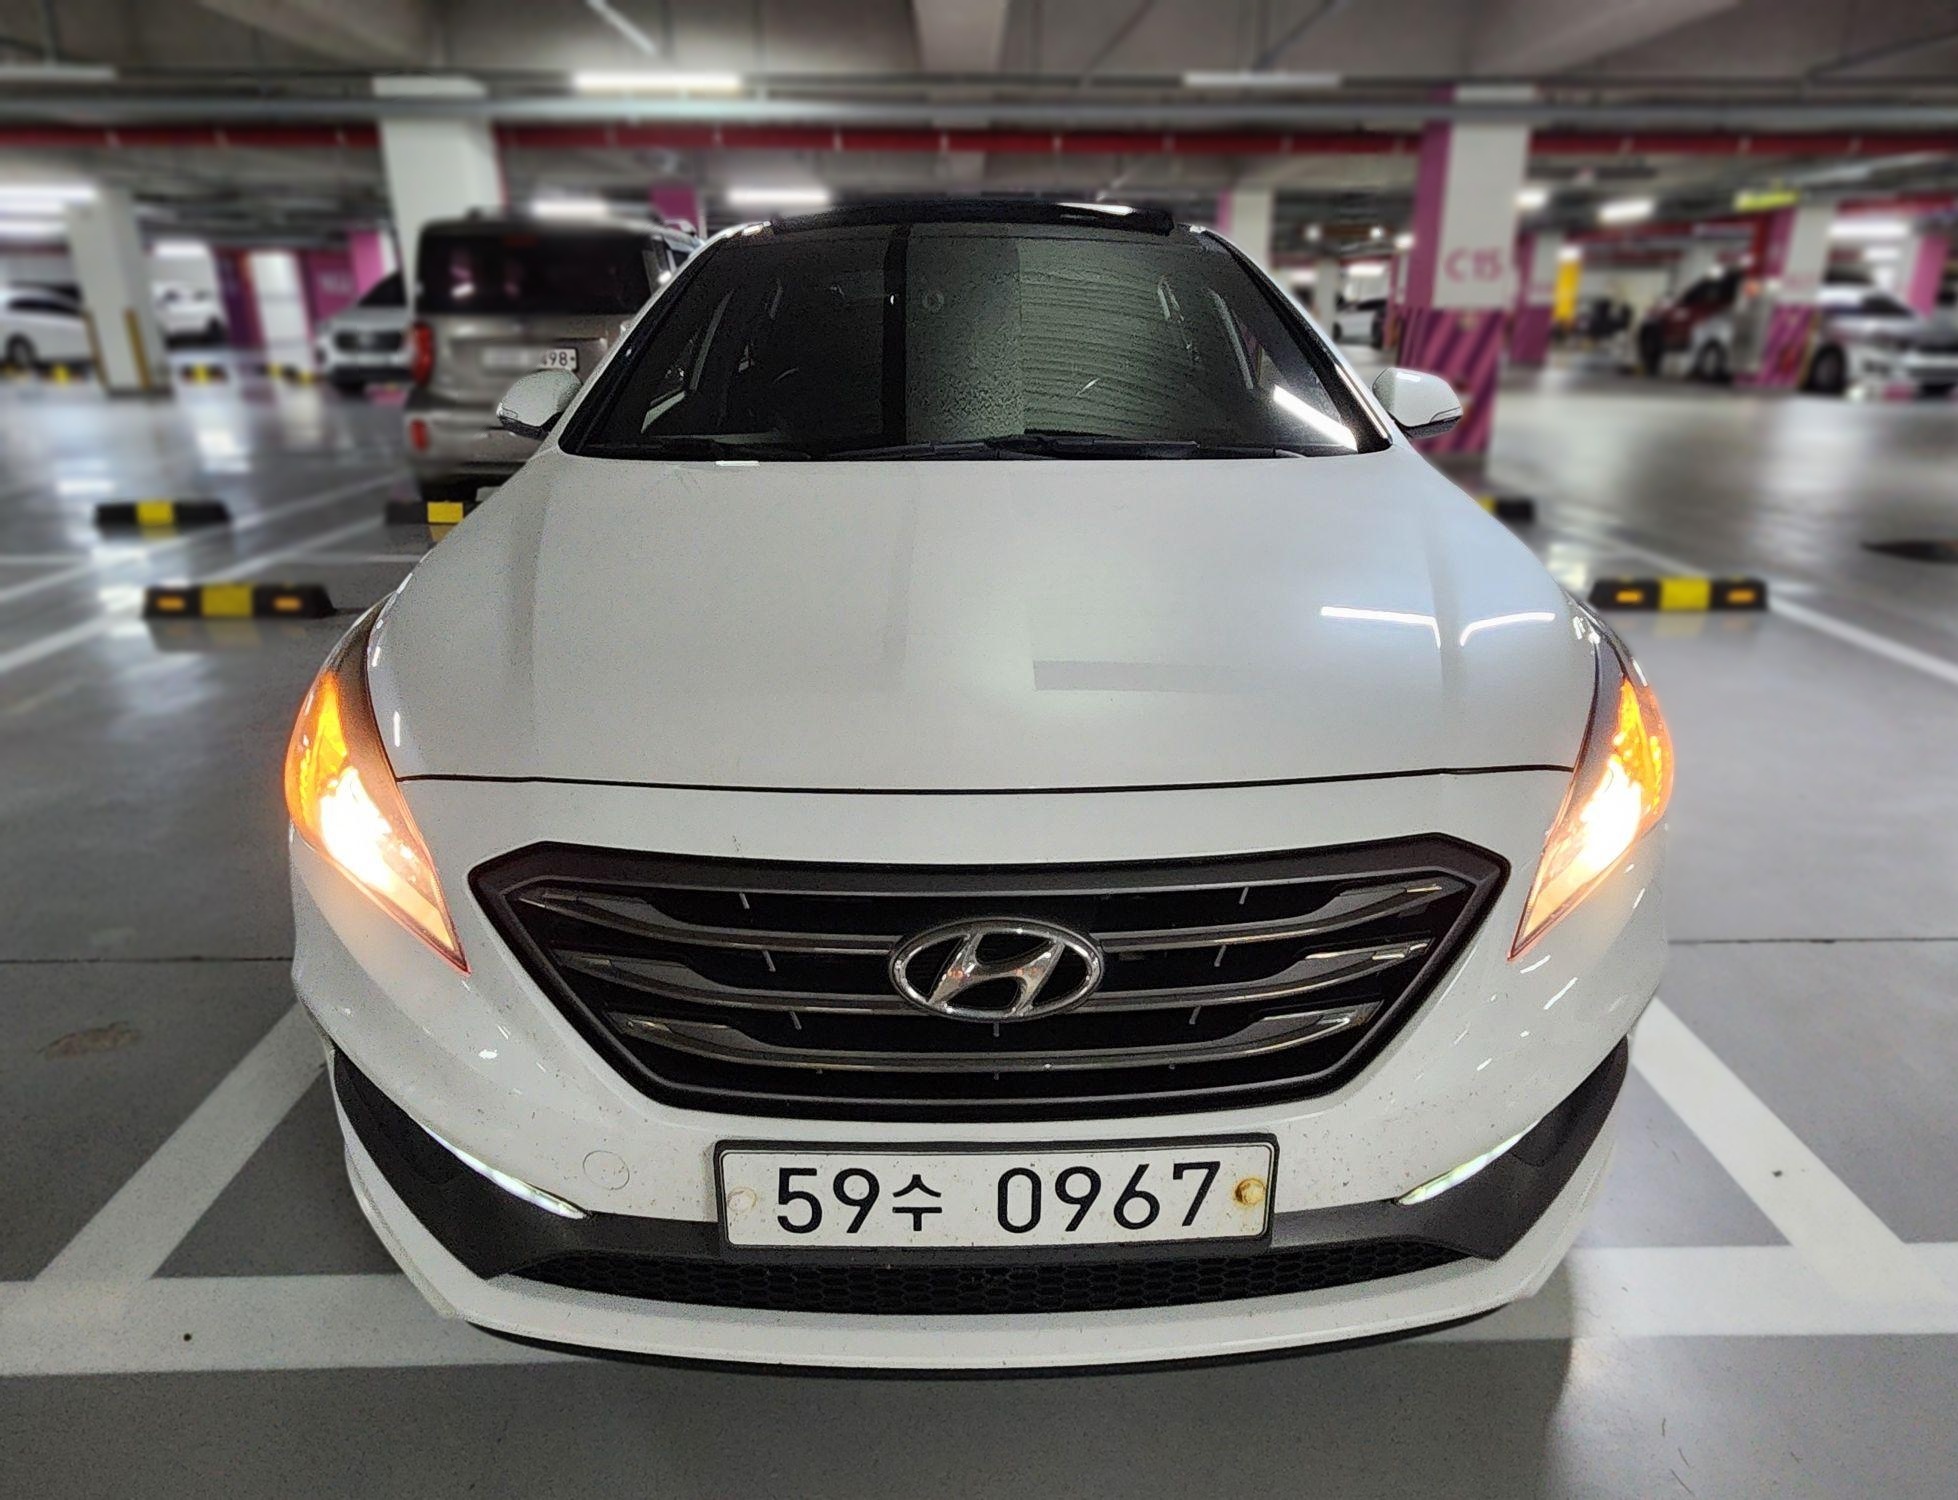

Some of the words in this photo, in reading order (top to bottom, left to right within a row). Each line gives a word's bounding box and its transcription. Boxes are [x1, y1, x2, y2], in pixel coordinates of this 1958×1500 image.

[1443, 246, 1503, 284] C15
[777, 1167, 942, 1234] 59수
[997, 1160, 1221, 1234] 0967
